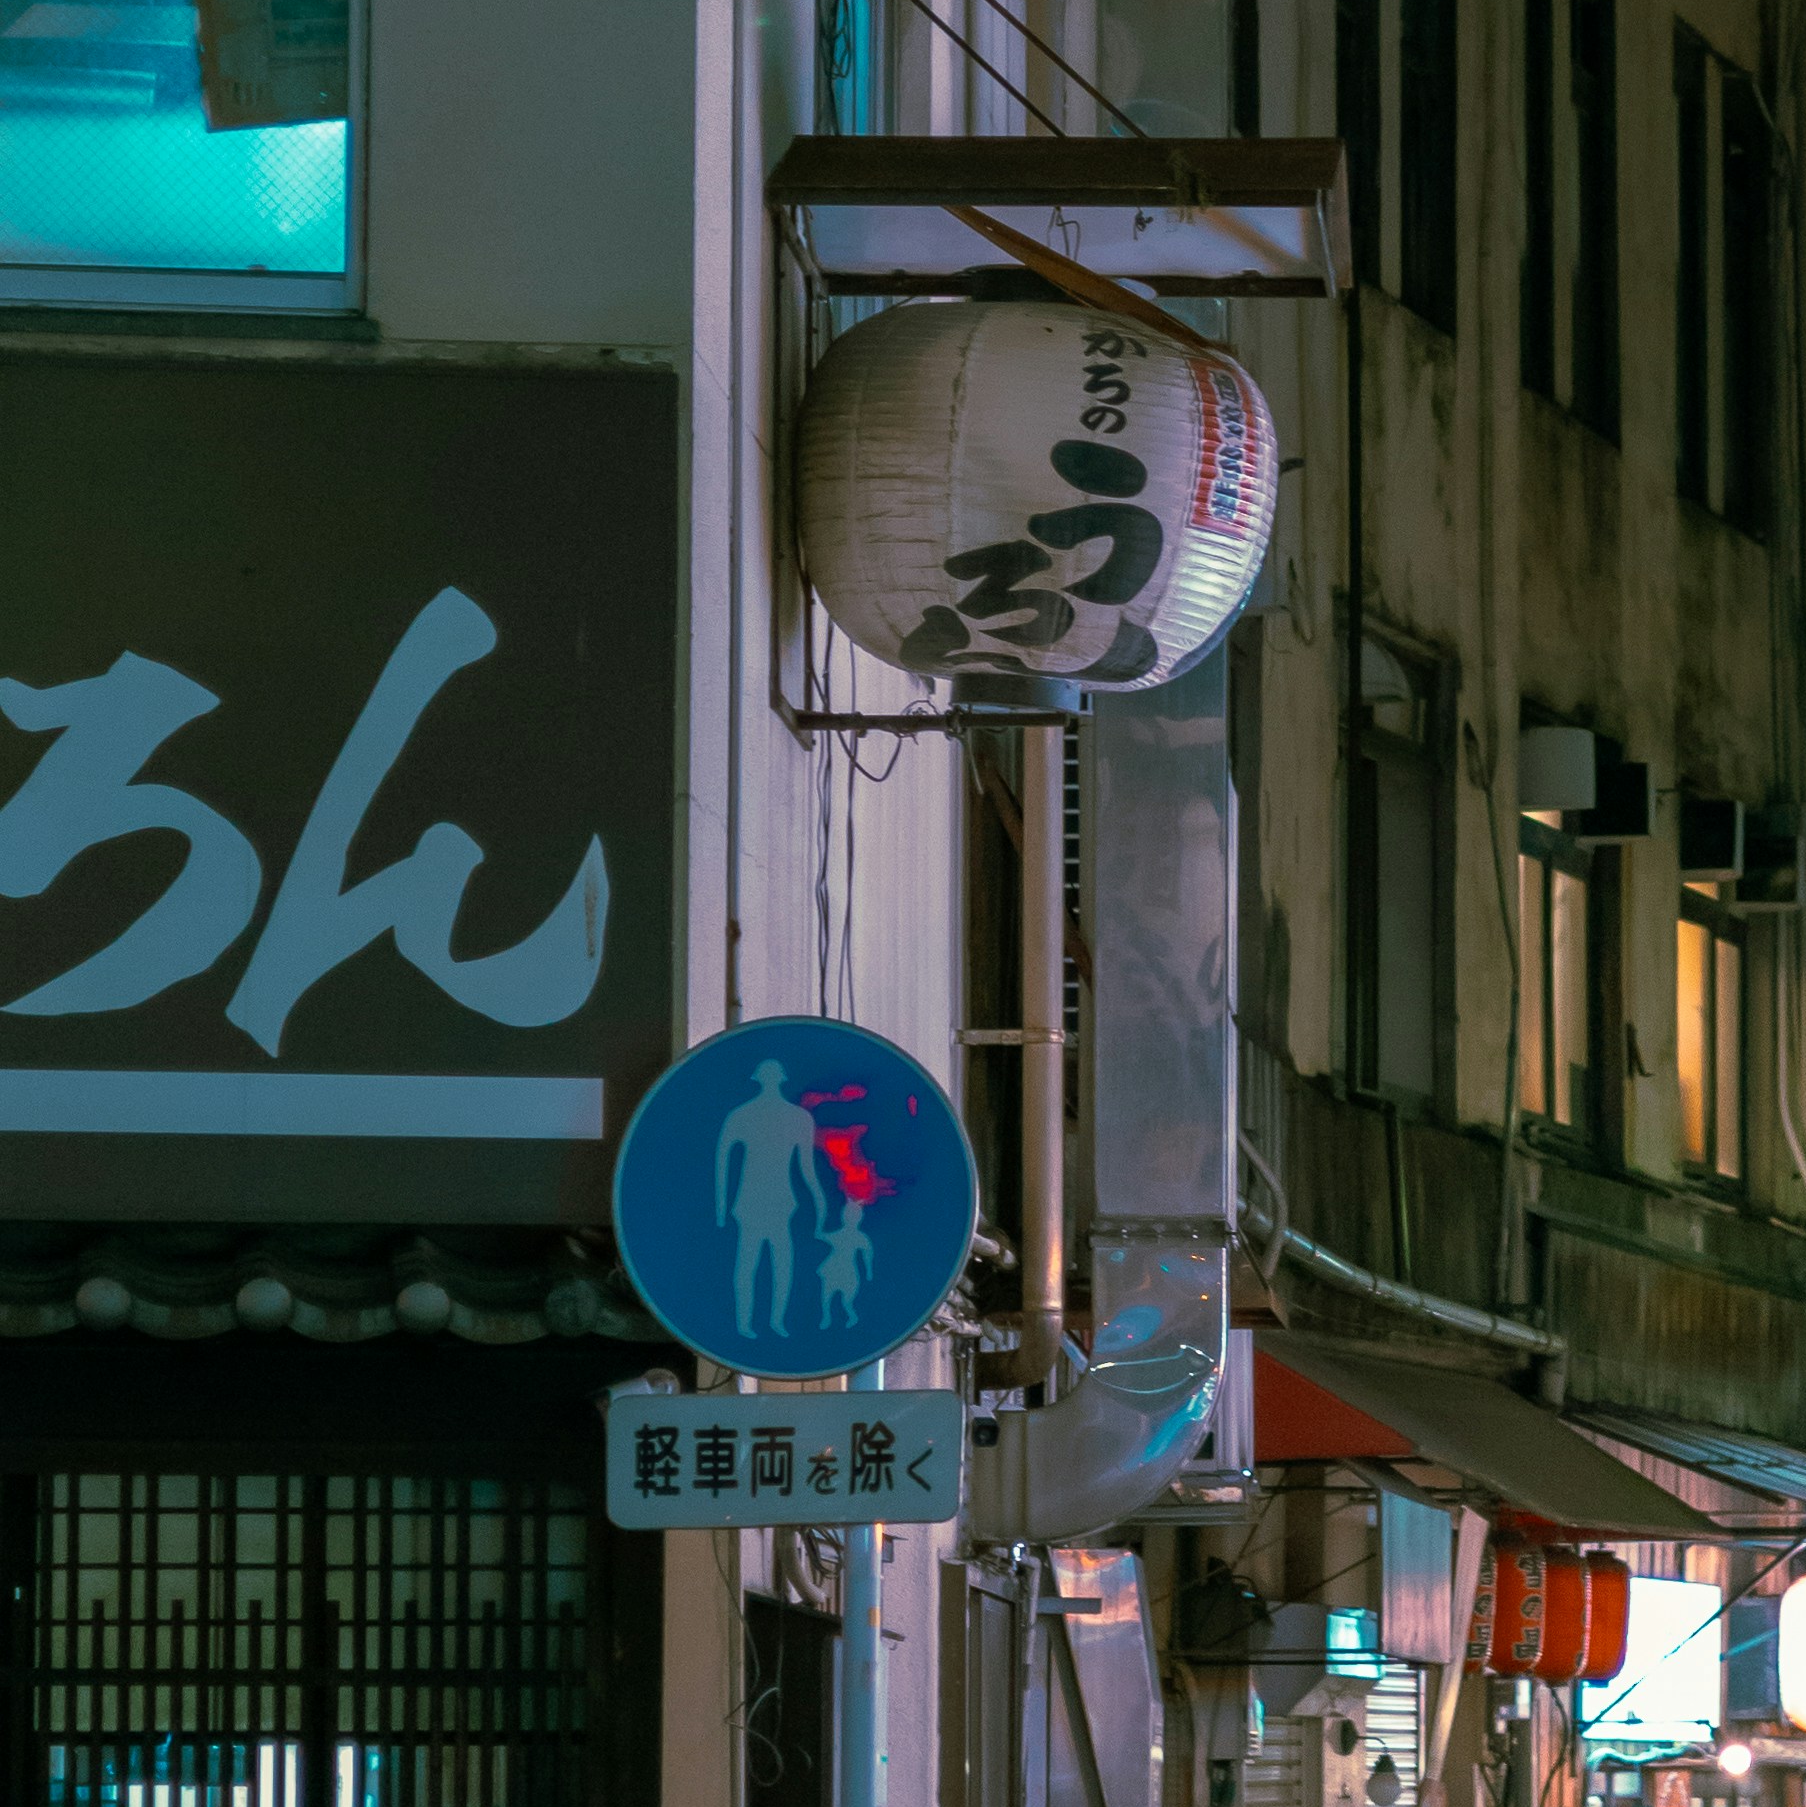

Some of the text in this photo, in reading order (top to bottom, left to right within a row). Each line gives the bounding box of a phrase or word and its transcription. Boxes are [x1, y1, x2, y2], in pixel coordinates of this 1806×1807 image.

[1080, 331, 1148, 435] かろの
[898, 438, 1164, 683] うろん
[0, 585, 610, 1060] ろん
[632, 1421, 935, 1500] 軽車両を除く
